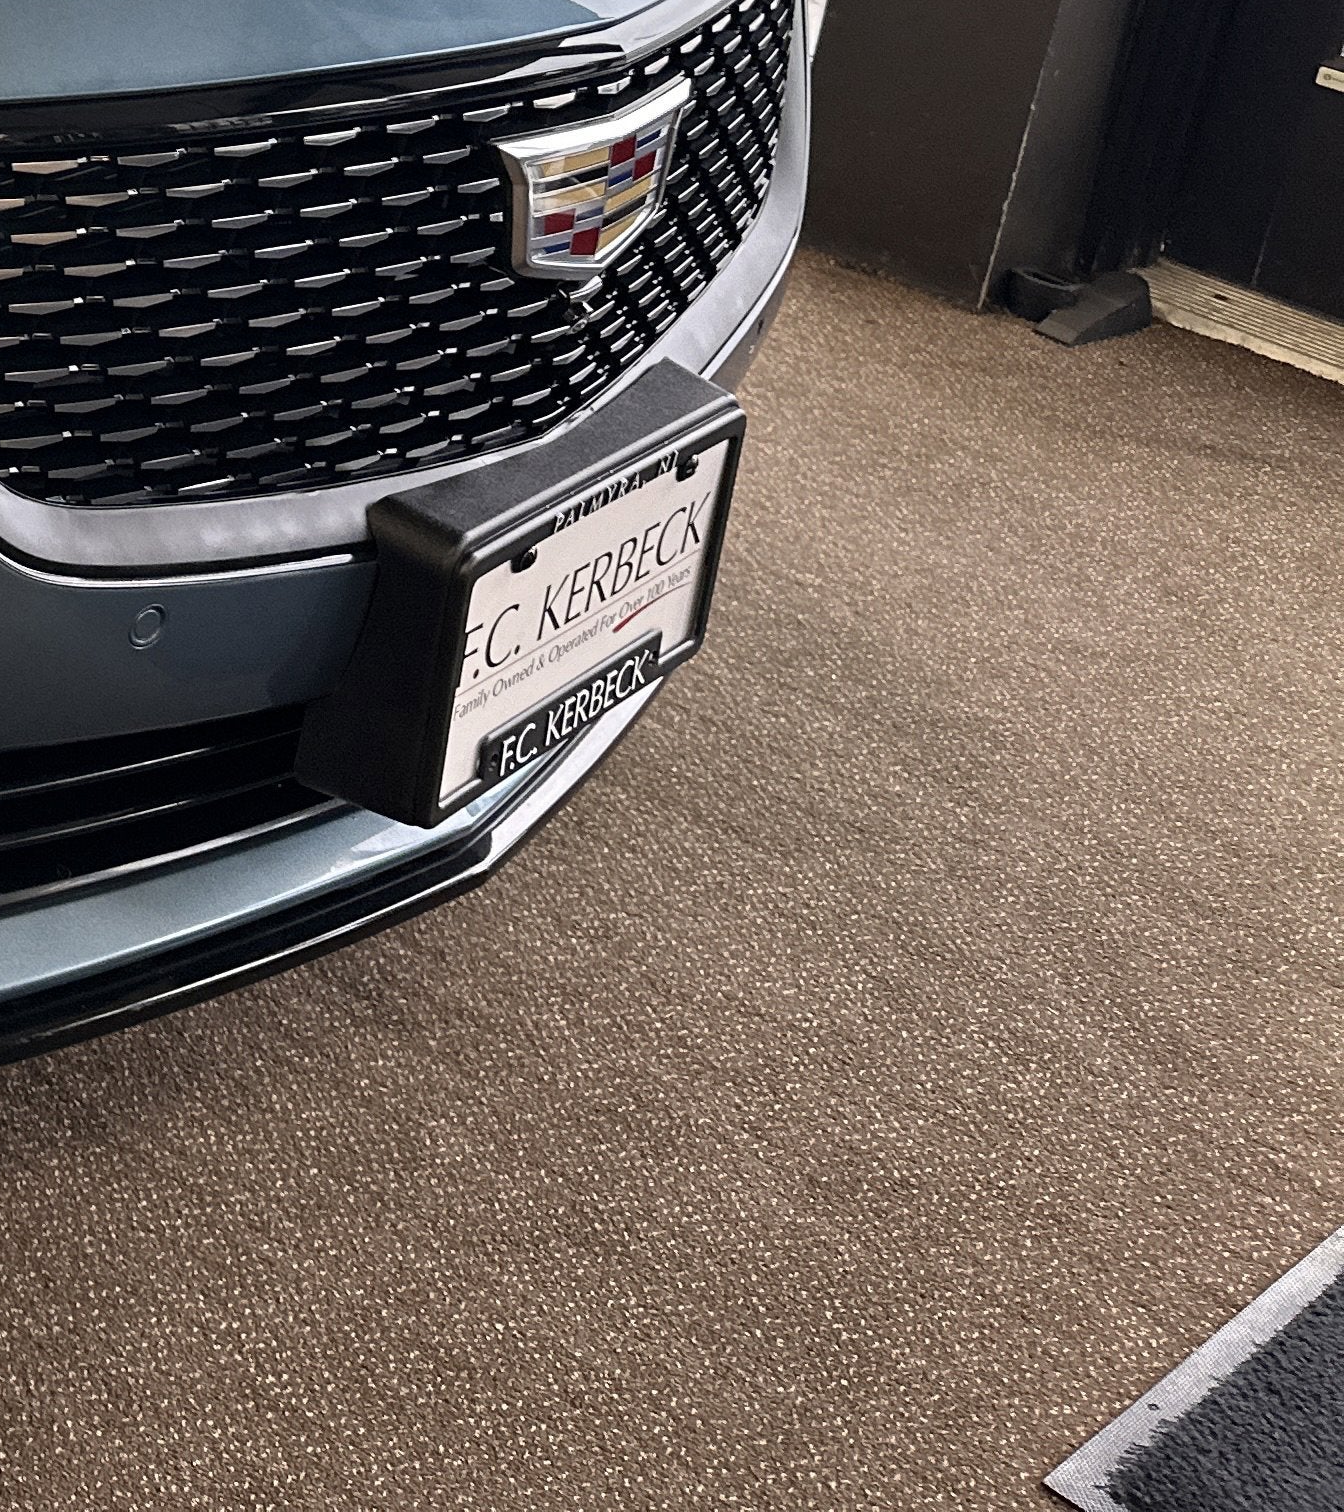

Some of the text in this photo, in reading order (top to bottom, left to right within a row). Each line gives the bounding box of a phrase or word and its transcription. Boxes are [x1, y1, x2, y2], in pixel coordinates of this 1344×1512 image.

[536, 490, 712, 642] KERBECK
[453, 565, 692, 722] Family Owned & Operated For Over 100 Years
[499, 649, 650, 777] F.C. KERBECK
